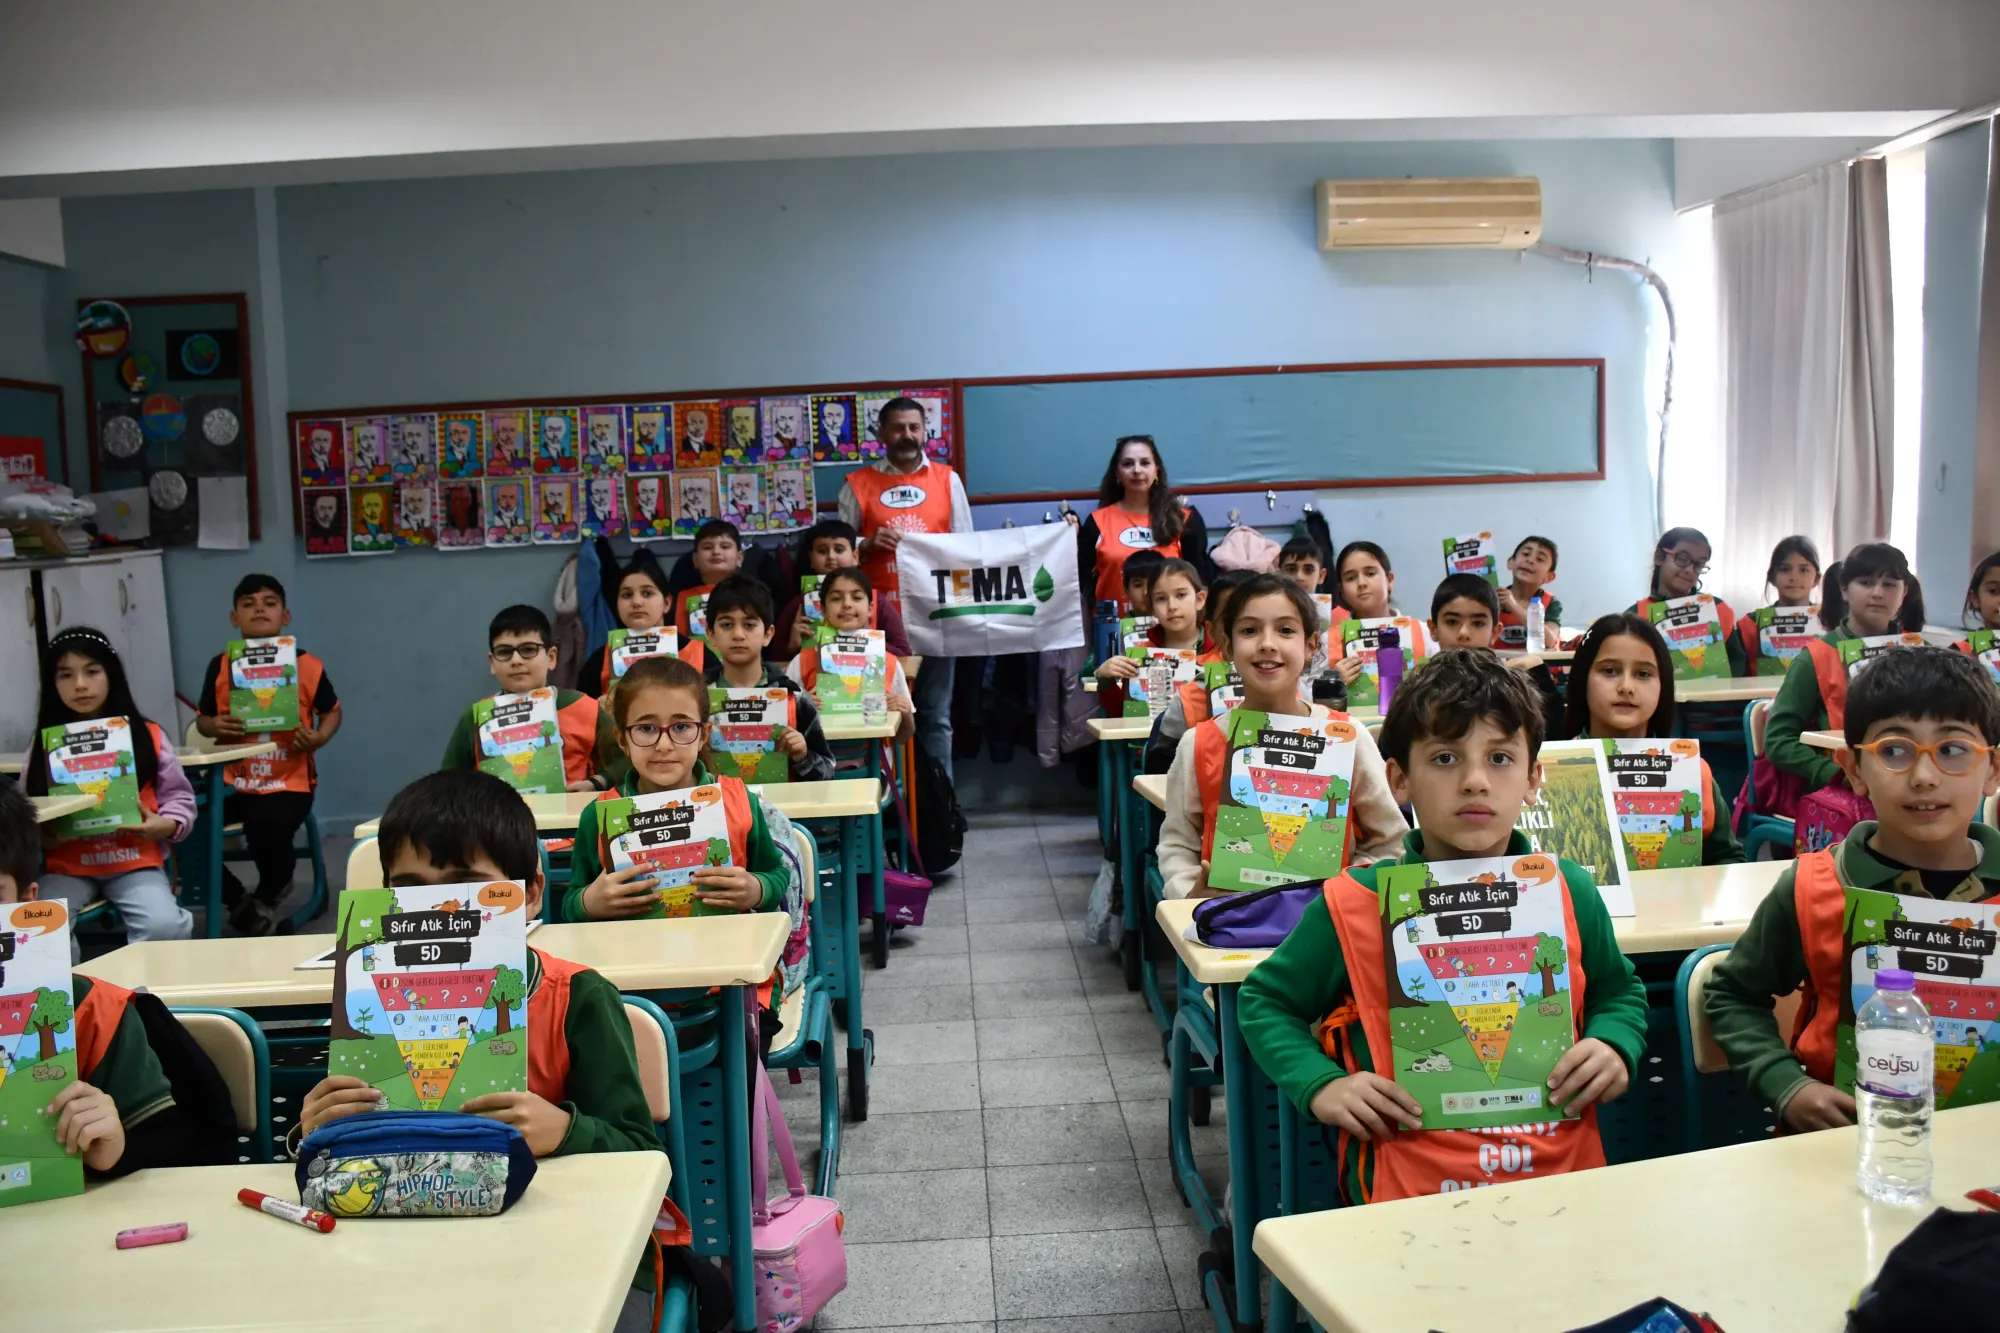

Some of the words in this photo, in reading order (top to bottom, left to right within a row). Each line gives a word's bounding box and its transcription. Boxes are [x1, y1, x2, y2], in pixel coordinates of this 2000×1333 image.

[930, 565, 1027, 603] TEMA
[1263, 734, 1281, 745] Sıfır
[1283, 737, 1299, 746] Atık
[1302, 736, 1319, 750] İçin
[1281, 753, 1296, 765] 5D
[1613, 758, 1631, 767] Sıfır
[1633, 758, 1649, 767] Atık
[1651, 756, 1667, 769] İçin
[1634, 775, 1648, 785] 5D
[633, 816, 651, 827] Sıfır
[654, 813, 670, 824] Atık
[672, 810, 690, 822] İçin
[656, 829, 671, 841] 5D
[1522, 861, 1545, 872] İlkokul
[488, 888, 512, 899] İlkokul
[1428, 892, 1454, 906] Sıfır
[1459, 890, 1481, 903] Atık
[1486, 886, 1509, 903] İçin
[24, 908, 52, 920] İlkokul
[391, 920, 416, 933] Sıfır
[421, 919, 443, 932] Atık
[448, 914, 472, 932] İçin
[1461, 915, 1482, 931] 5D
[1894, 927, 1921, 942] Sıfır
[1926, 931, 1951, 945] Atık
[1958, 932, 1985, 949] İçin
[421, 945, 441, 961] 5D
[1926, 956, 1949, 972] 5D
[1479, 1138, 1533, 1177] ÇÖL
[396, 1173, 455, 1195] HIPHOP
[435, 1188, 487, 1208] STYLE
